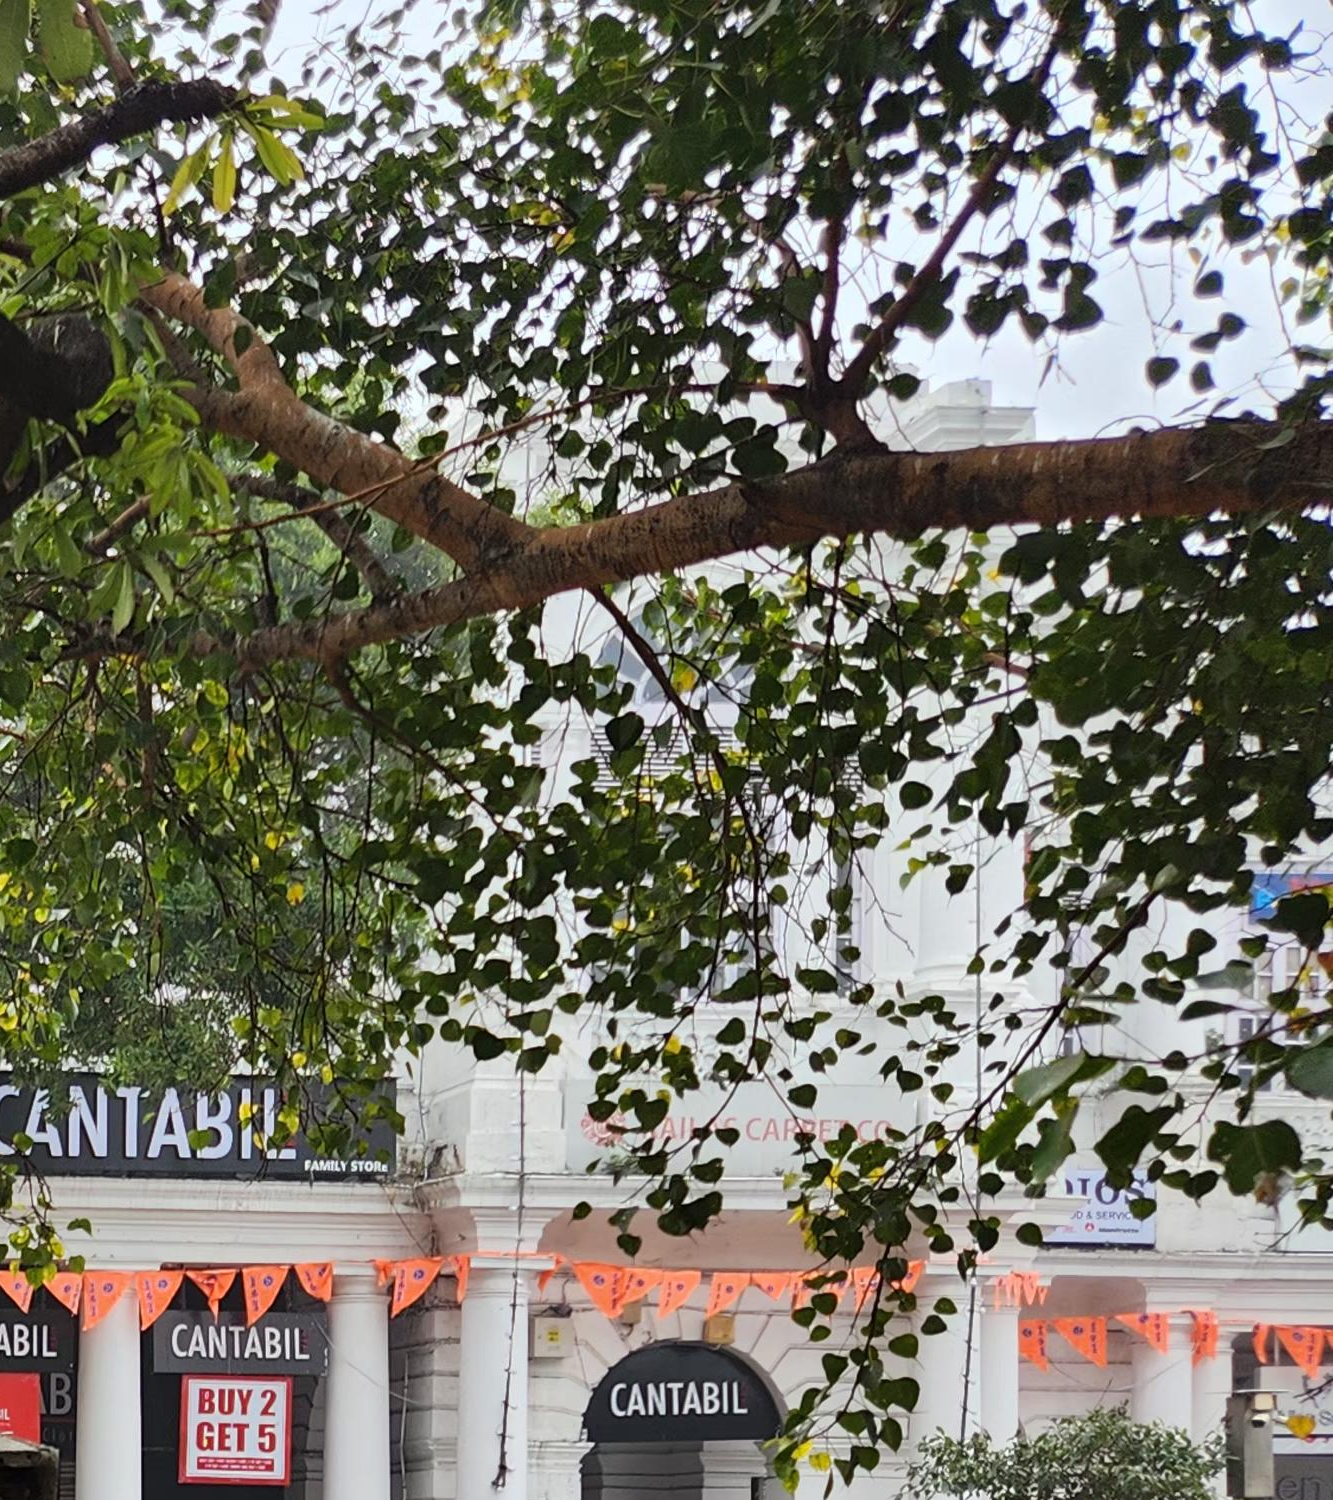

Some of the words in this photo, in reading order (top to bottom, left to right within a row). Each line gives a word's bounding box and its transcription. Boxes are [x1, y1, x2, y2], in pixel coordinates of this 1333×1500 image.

[304, 1160, 347, 1172] FAMILY
[171, 1323, 311, 1360] CANTABIL
[197, 1388, 253, 1416] BUY
[260, 1389, 277, 1417] 2
[610, 1380, 749, 1417] CANTABIL
[195, 1421, 250, 1453] GET
[257, 1423, 277, 1453] 5
